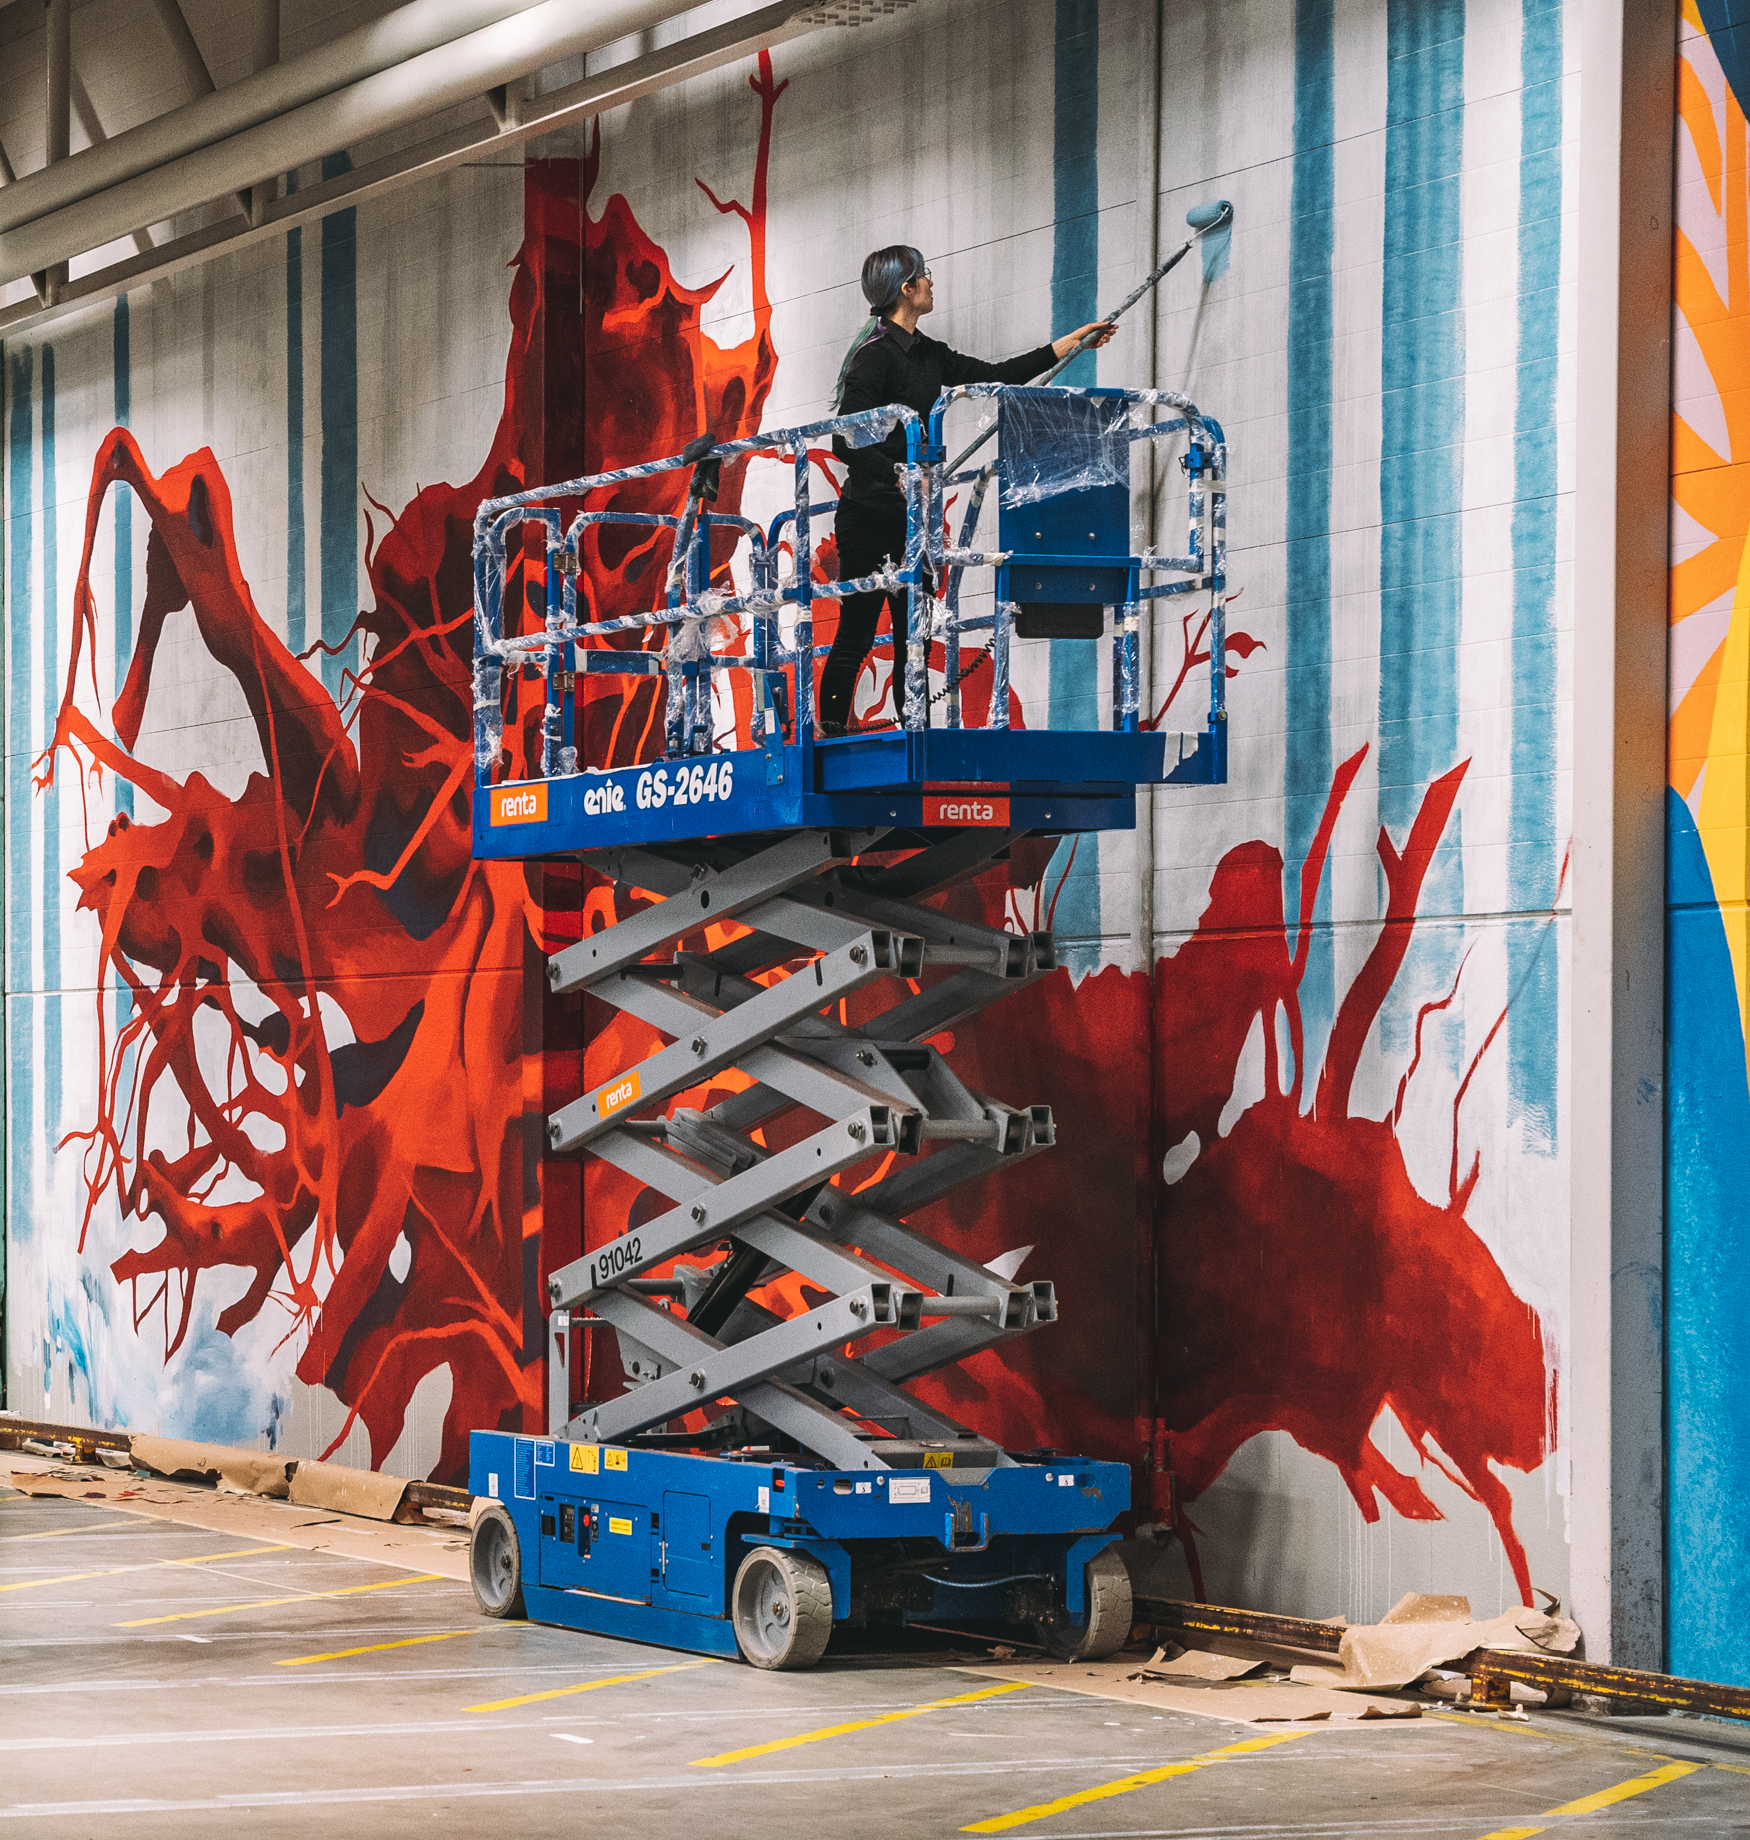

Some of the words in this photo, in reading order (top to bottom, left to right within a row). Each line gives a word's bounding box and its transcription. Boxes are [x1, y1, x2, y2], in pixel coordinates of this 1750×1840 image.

[636, 761, 734, 810] GS-2646
[501, 791, 537, 818] renta
[939, 801, 994, 820] renta
[606, 1082, 633, 1109] renta
[599, 1236, 643, 1280] 91042
